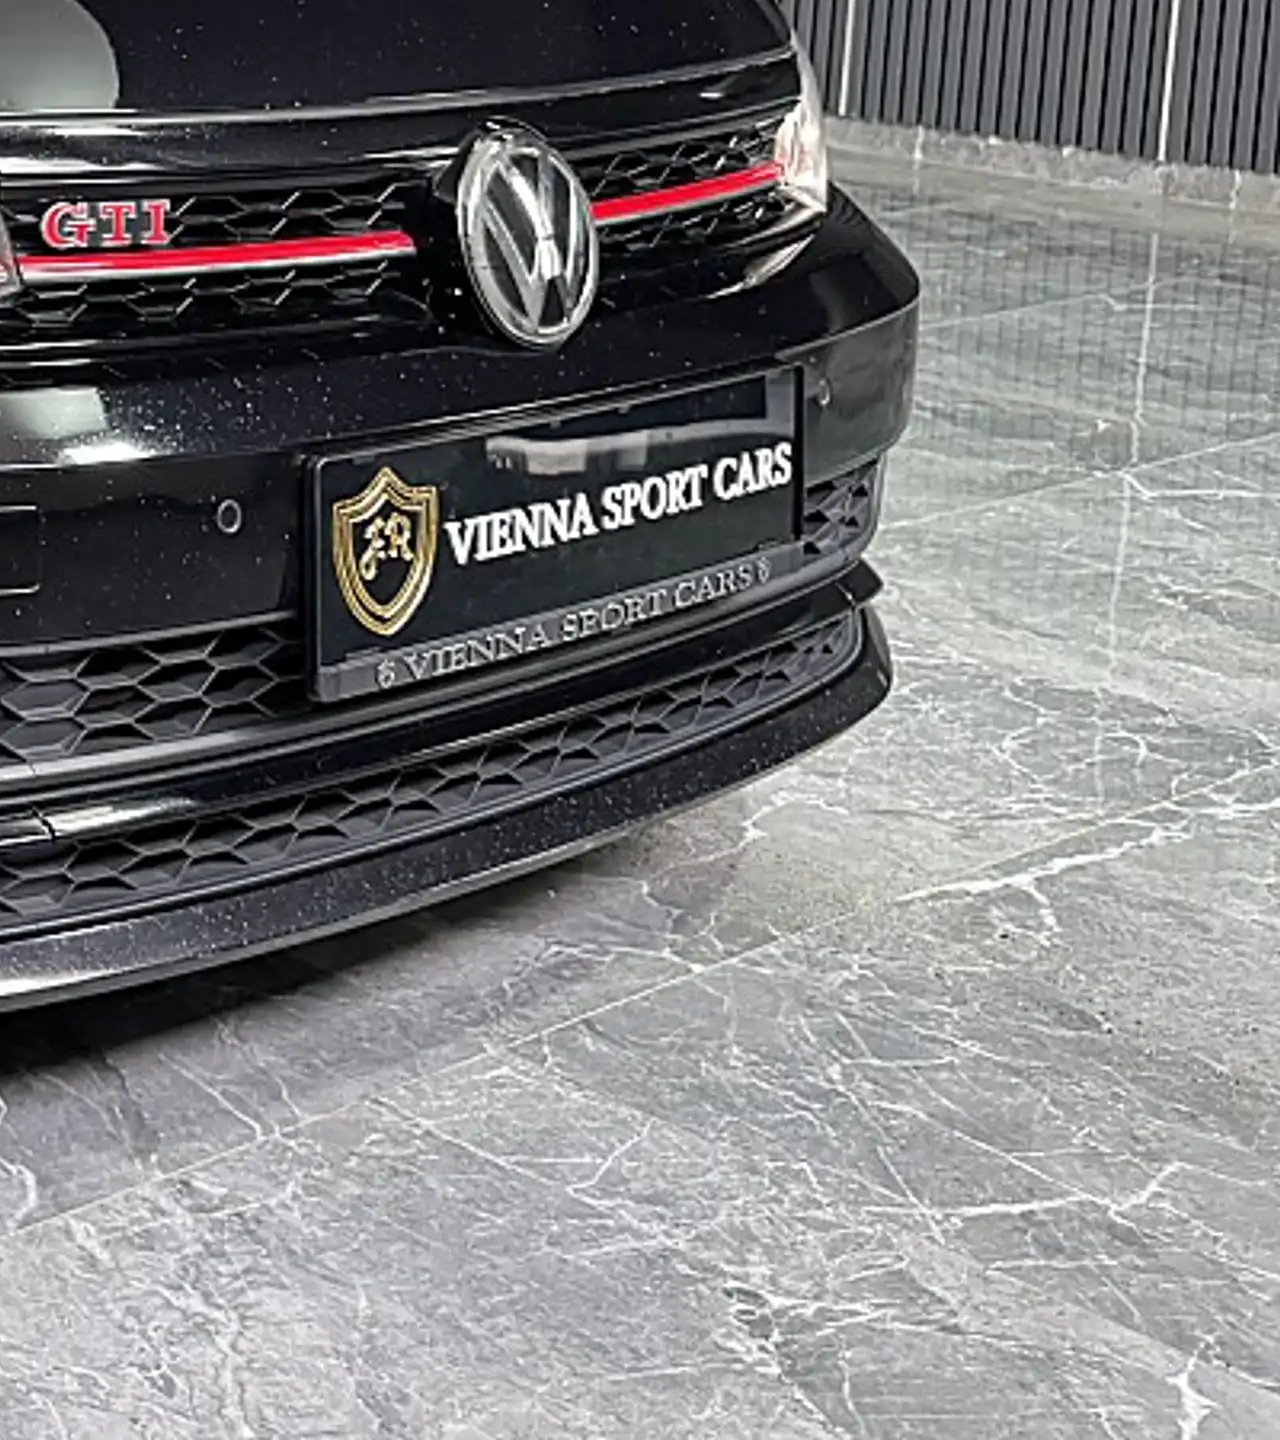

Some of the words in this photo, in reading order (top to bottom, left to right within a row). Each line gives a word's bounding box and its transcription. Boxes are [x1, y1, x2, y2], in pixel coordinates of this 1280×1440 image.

[40, 198, 172, 249] GTI
[443, 492, 599, 565] VIENNA
[600, 461, 709, 531] SPORT
[712, 441, 793, 501] CARS
[401, 623, 553, 682] VIENNA
[560, 588, 668, 643] SPORT
[673, 560, 753, 610] CARS
